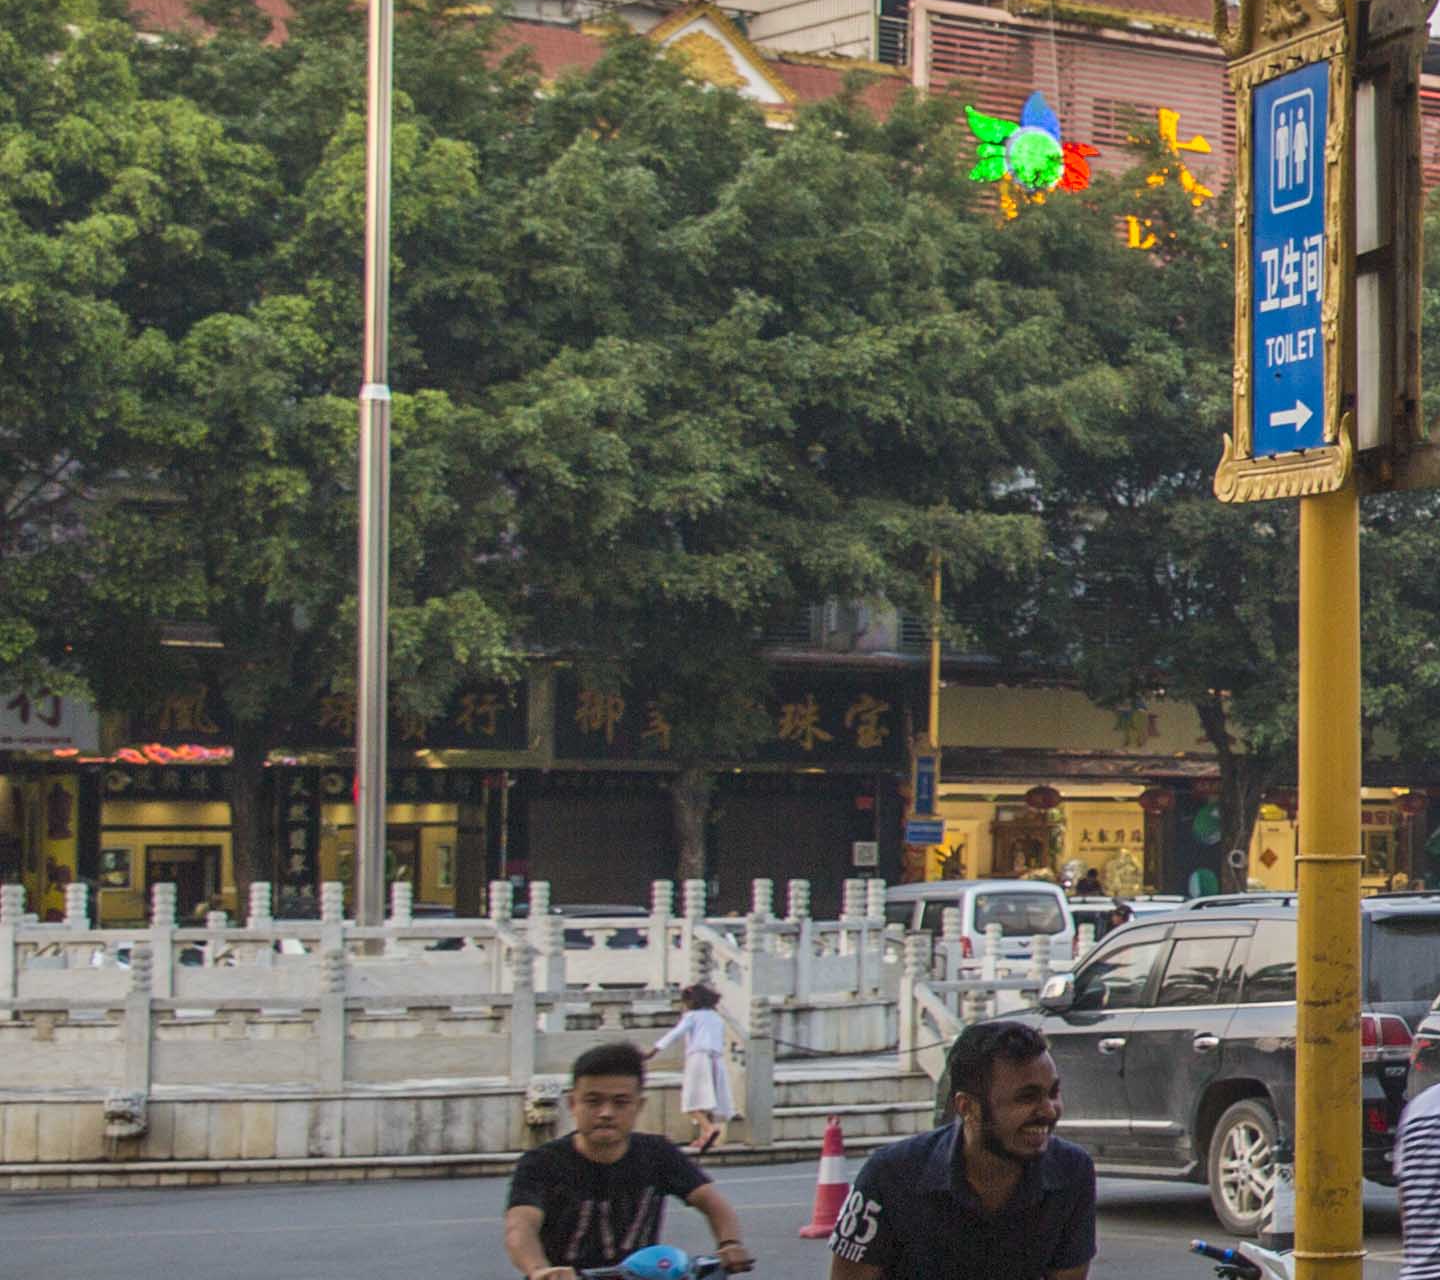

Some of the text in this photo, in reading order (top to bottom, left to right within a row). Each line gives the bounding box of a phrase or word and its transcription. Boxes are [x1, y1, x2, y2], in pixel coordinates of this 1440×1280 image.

[1260, 235, 1324, 313] 卫生间
[1266, 328, 1316, 366] TOILET
[839, 1190, 882, 1243] 85
